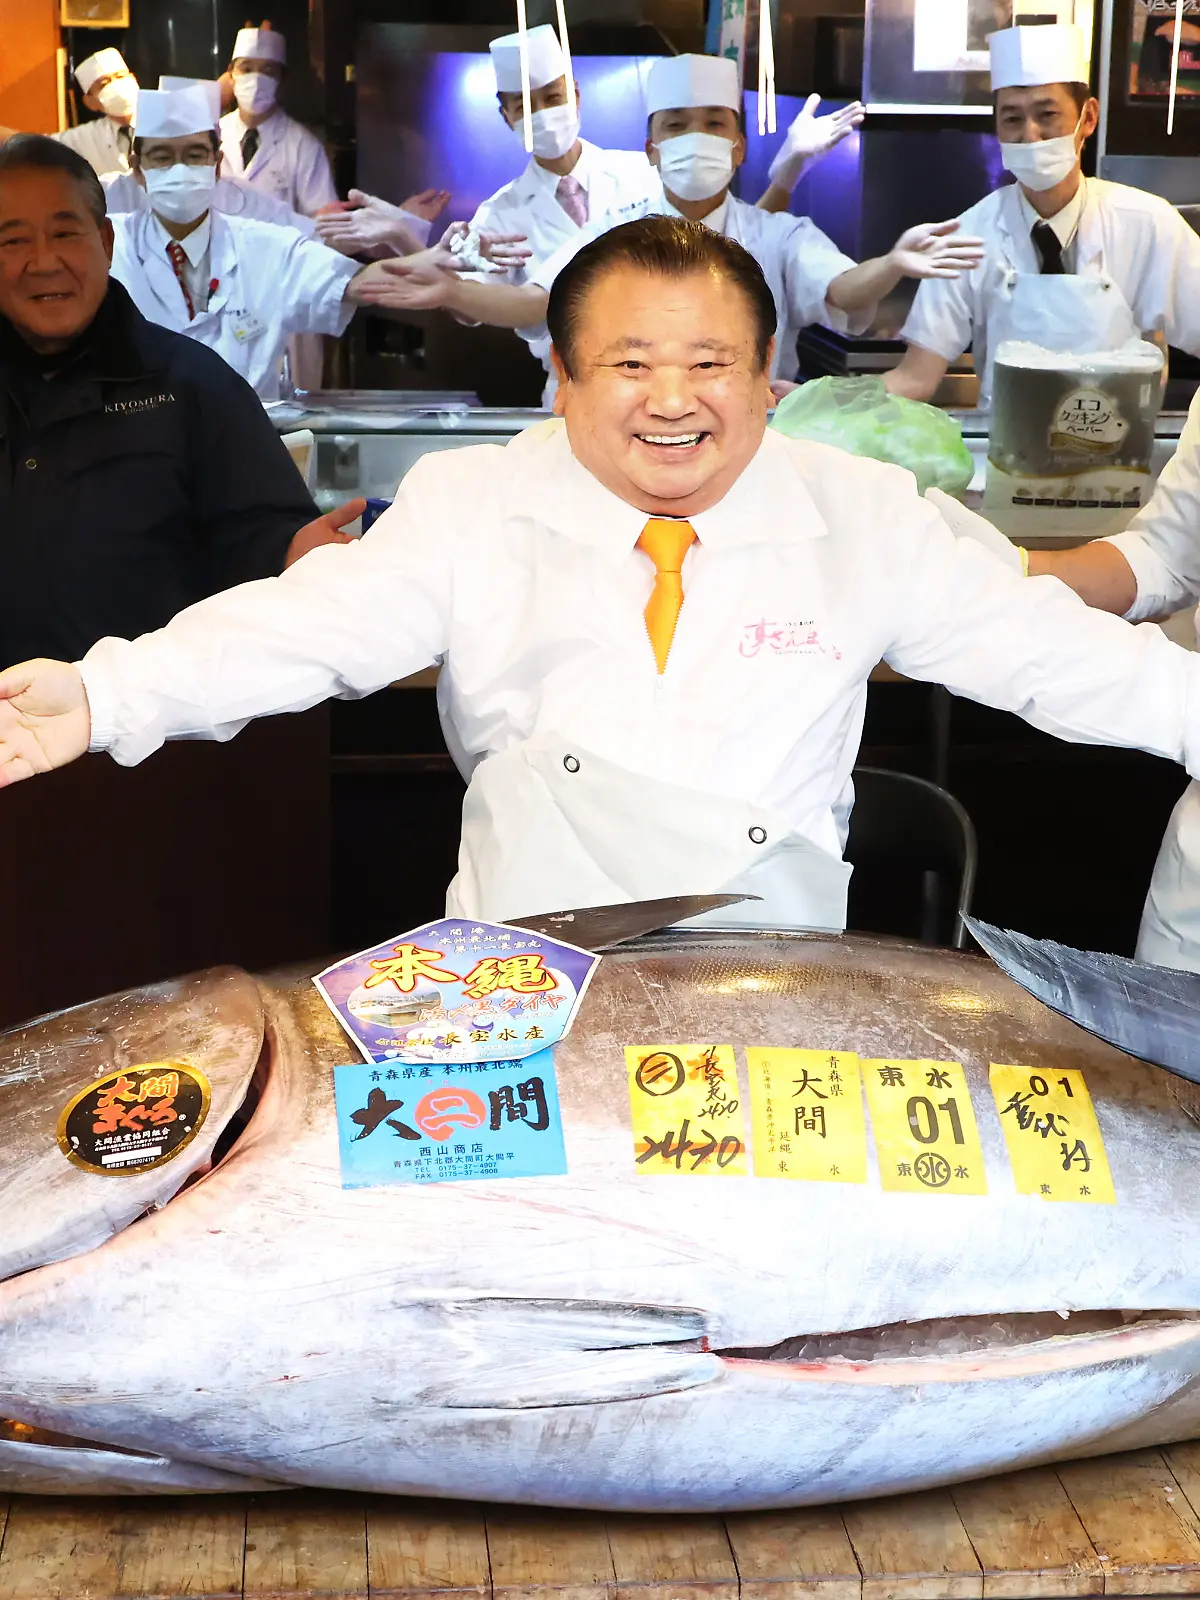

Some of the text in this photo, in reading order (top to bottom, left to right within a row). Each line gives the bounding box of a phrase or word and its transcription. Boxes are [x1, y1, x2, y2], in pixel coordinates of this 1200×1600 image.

[104, 393, 176, 413] KIYOMURA
[1073, 399, 1101, 411] エコ
[1062, 410, 1112, 425] クッキング
[1066, 425, 1103, 434] ペーパー
[364, 943, 558, 1000] 本縄
[368, 1058, 523, 1082] 青森県産 本州最北端
[826, 1055, 844, 1097] 青森県
[97, 1071, 179, 1108] 大間
[1029, 1075, 1074, 1098] 01
[92, 1097, 178, 1134] まぐろ
[791, 1068, 829, 1139] 大間
[906, 1096, 965, 1145] 01
[419, 1143, 483, 1156] 西山商店
